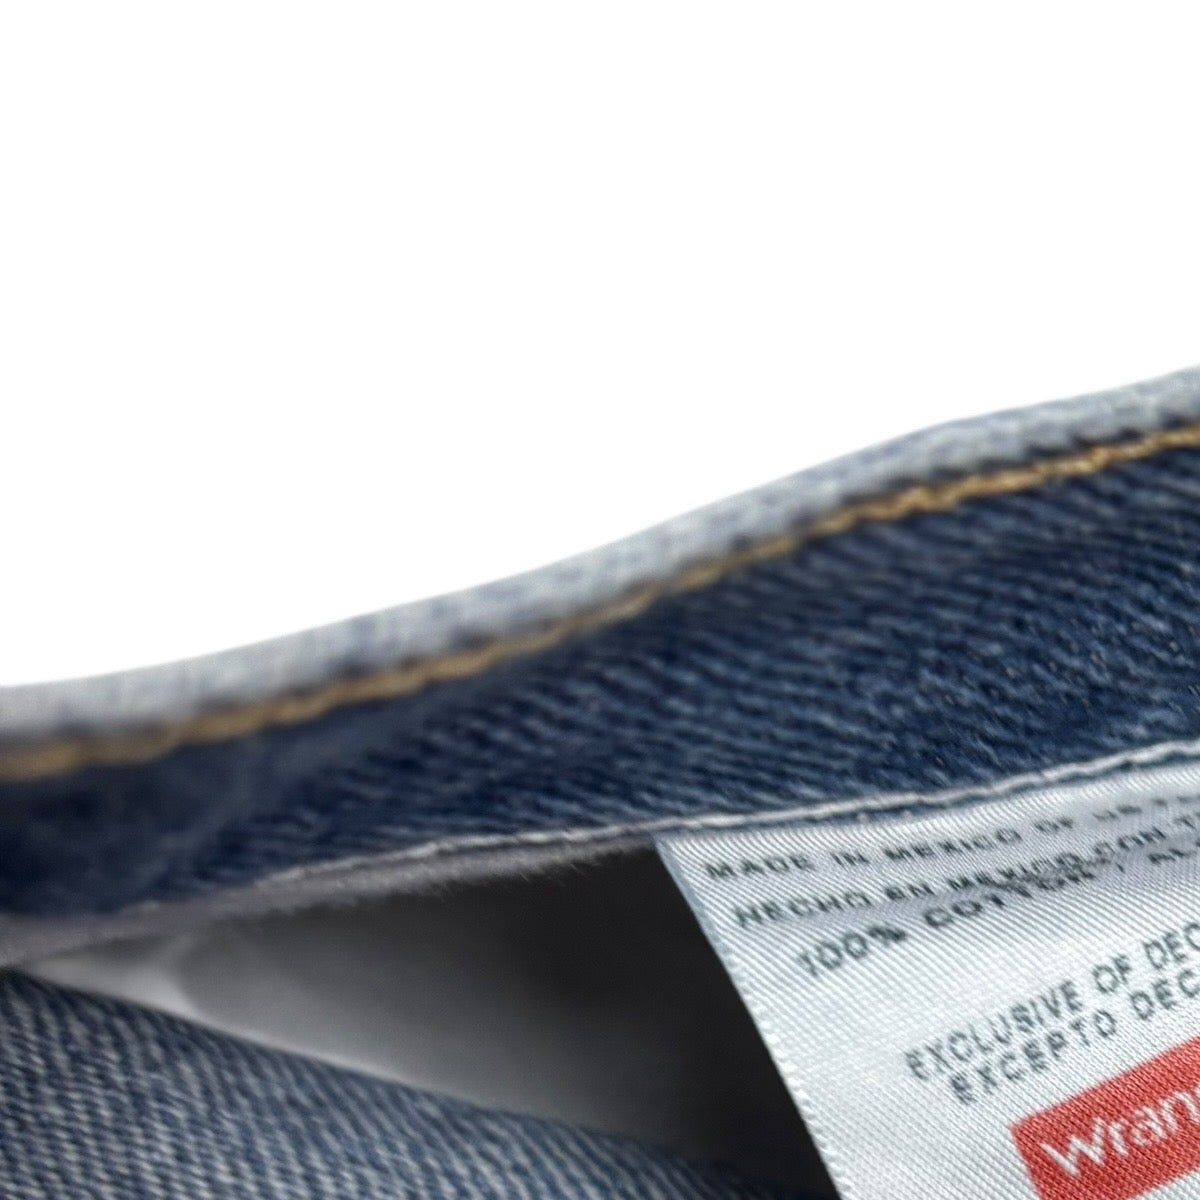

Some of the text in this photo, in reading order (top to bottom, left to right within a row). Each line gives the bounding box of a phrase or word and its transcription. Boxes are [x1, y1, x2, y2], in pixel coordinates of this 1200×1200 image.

[831, 851, 869, 866] IN
[798, 925, 906, 976] 100%
[904, 980, 1084, 1081] EXCLUSIVE
[1092, 955, 1134, 994] OF
[949, 1010, 1118, 1104] EXCEPTO
